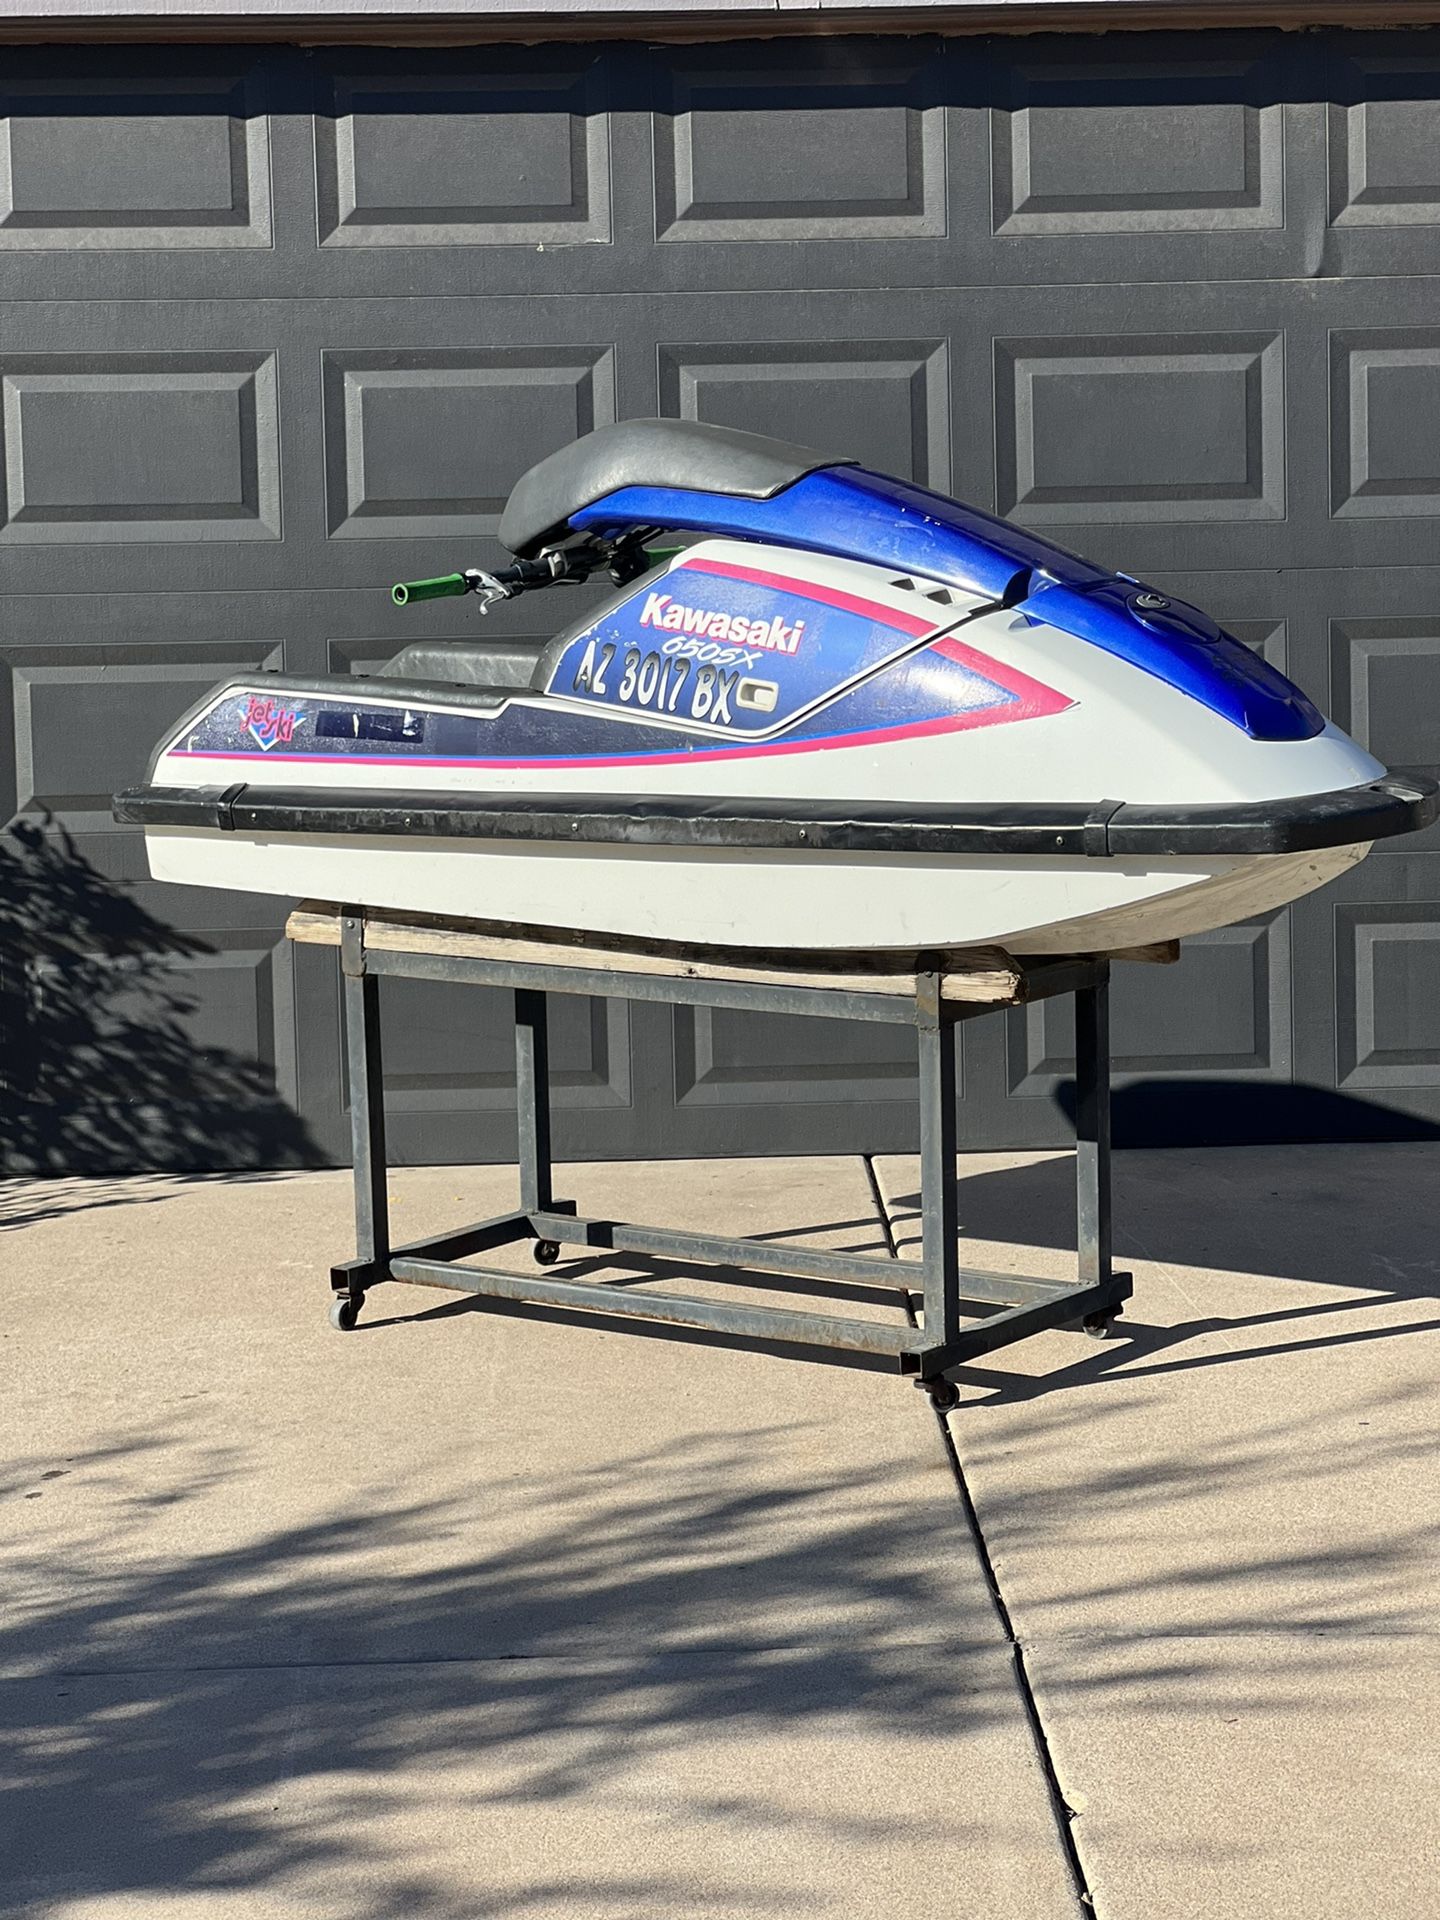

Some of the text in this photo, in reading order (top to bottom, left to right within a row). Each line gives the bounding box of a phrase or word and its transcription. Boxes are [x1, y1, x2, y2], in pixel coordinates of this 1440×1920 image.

[639, 592, 805, 656] Kawasaki
[661, 636, 763, 670] 650SX
[573, 640, 739, 725] AZ 3017 BX
